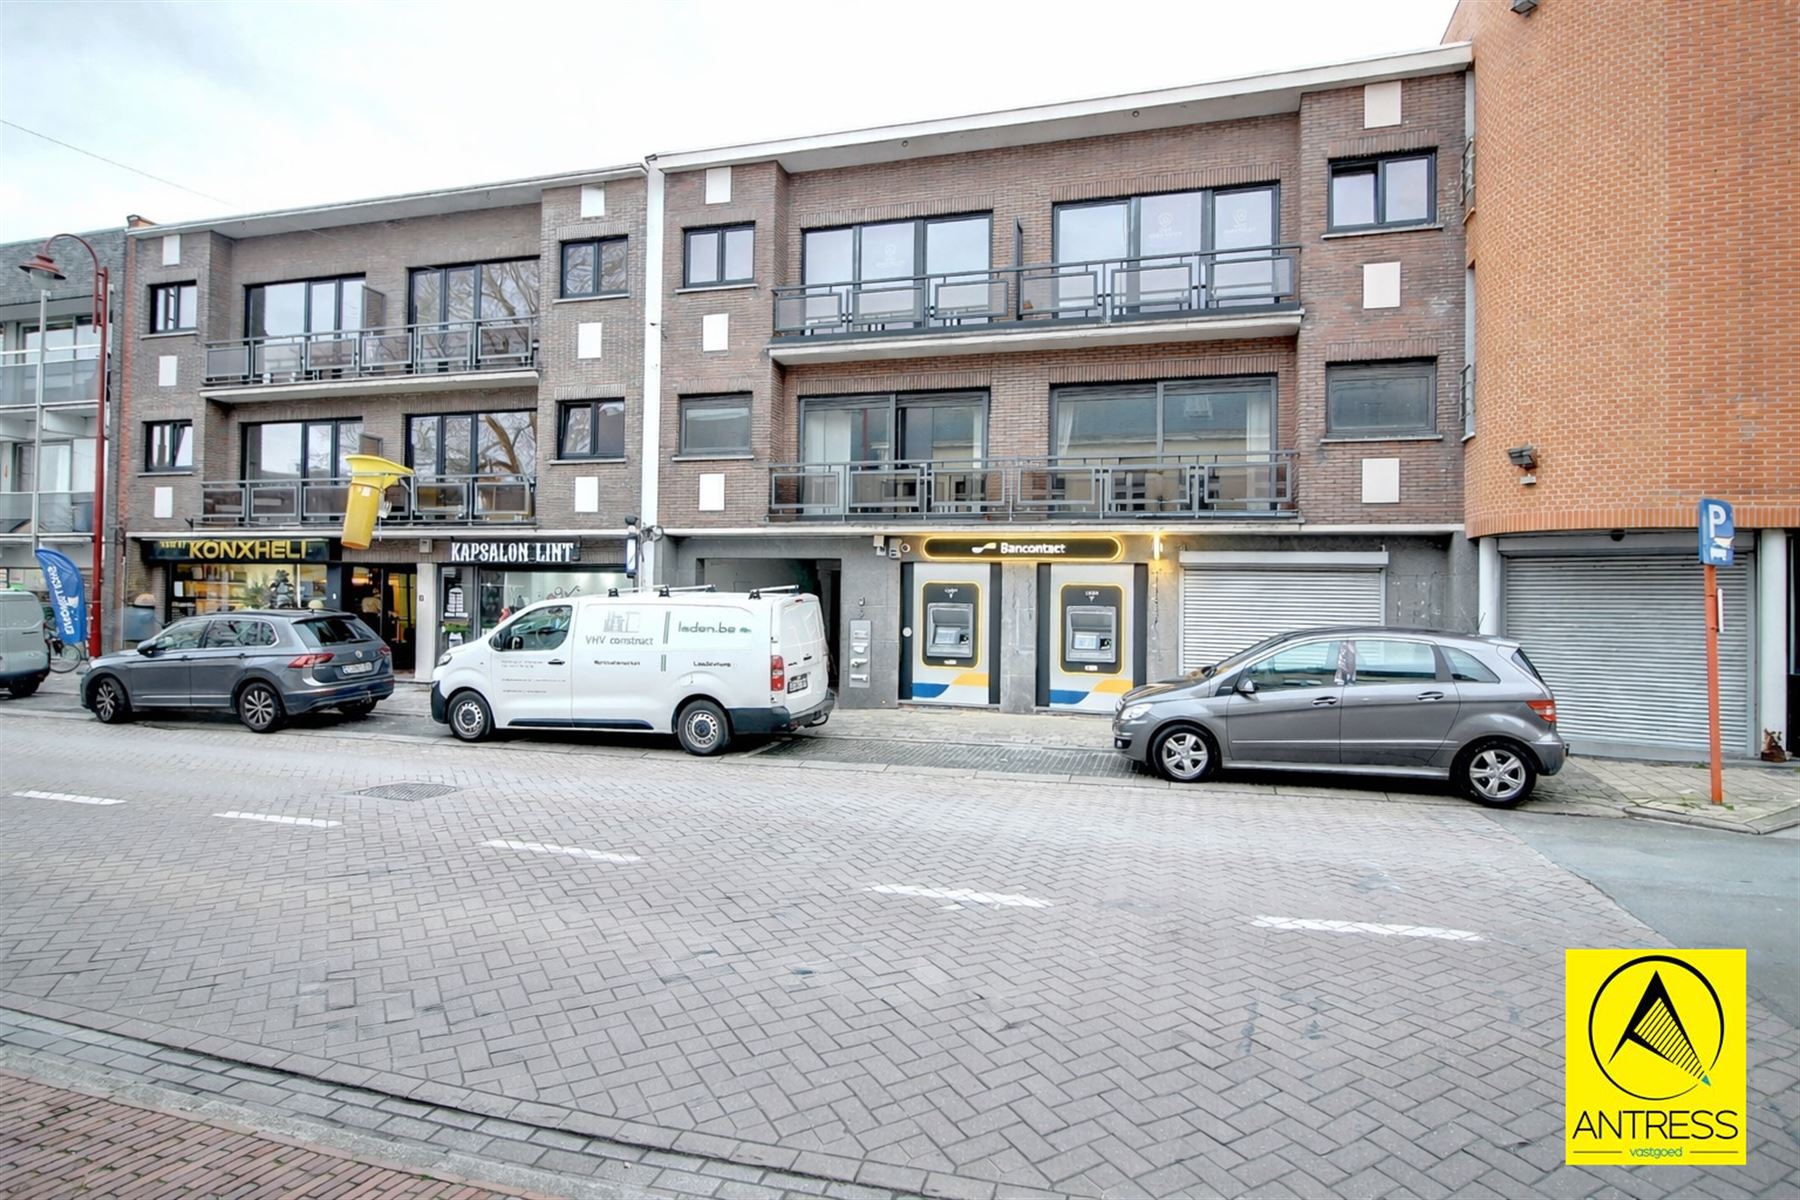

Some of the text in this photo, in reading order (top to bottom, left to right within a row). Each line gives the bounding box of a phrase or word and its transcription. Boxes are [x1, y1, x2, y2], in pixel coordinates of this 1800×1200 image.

[1708, 504, 1727, 538] P
[189, 540, 307, 559] KONXHELI
[451, 542, 574, 562] KAPSALON LINT
[1000, 542, 1066, 554] Bancontact
[585, 636, 606, 644] VHV
